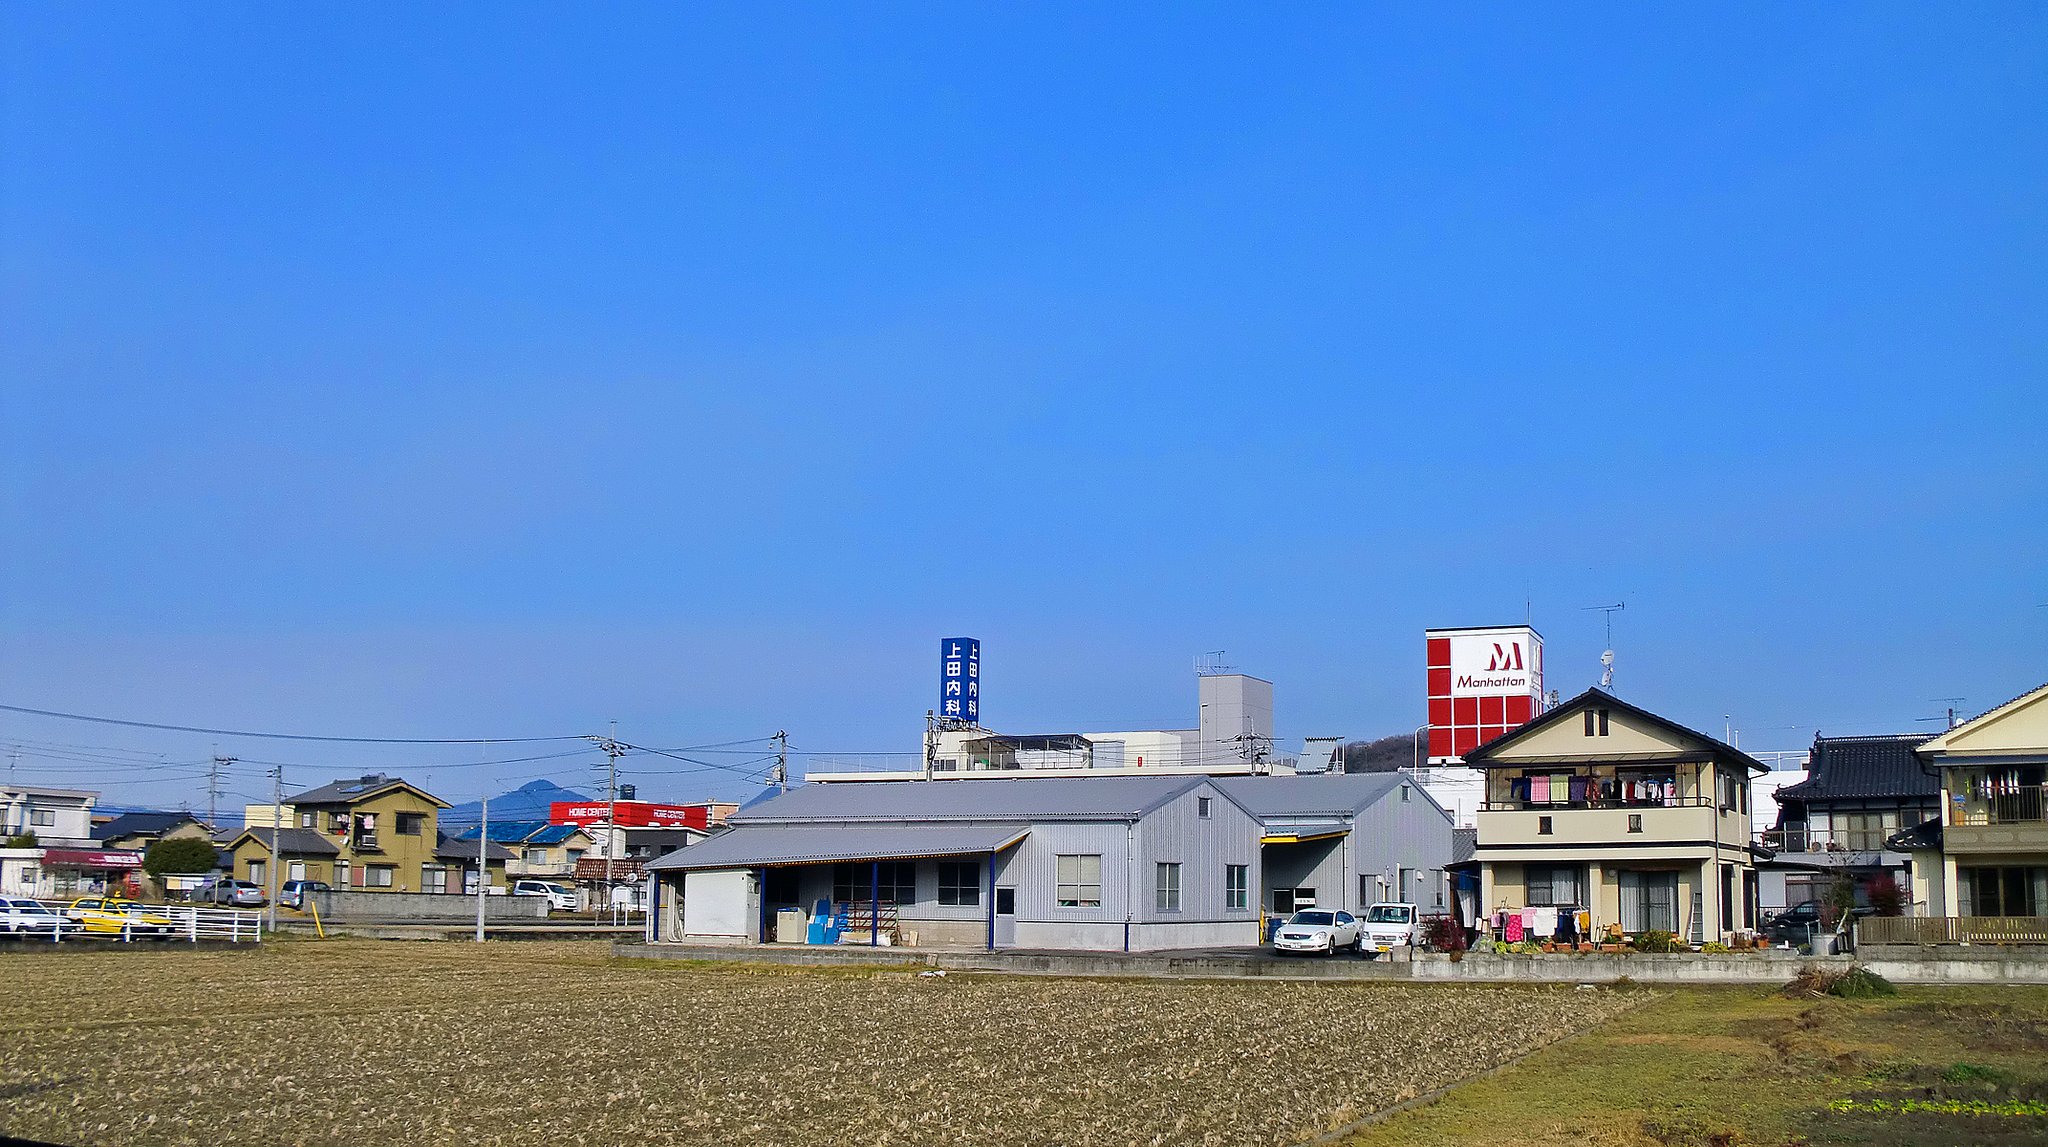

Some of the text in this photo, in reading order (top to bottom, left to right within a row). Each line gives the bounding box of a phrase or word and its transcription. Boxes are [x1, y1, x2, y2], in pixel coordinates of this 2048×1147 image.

[945, 642, 961, 715] 上田内科
[968, 644, 978, 716] 上田内科
[1457, 675, 1525, 688] Manhattan
[569, 808, 587, 817] HOME
[653, 809, 667, 818] HOME
